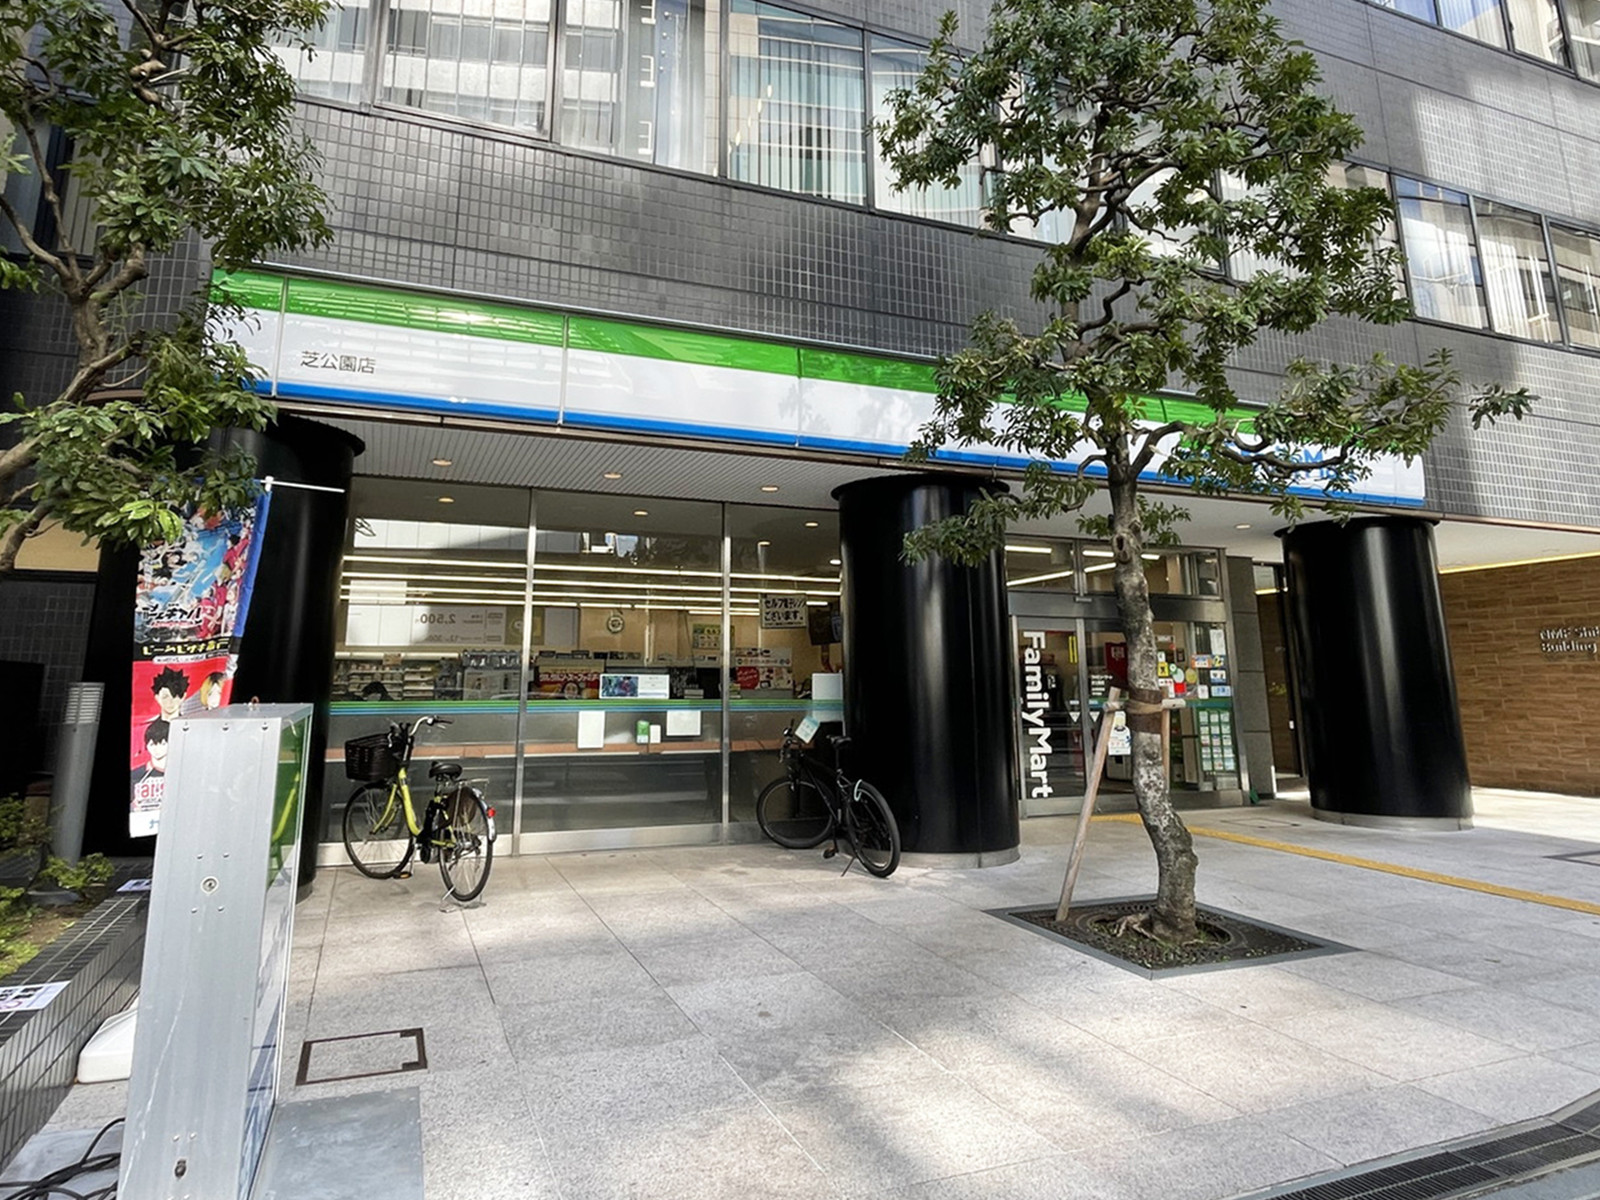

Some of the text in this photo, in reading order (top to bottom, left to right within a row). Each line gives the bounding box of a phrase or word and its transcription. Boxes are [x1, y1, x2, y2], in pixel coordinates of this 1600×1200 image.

[300, 350, 377, 375] 芝公園店
[1541, 640, 1598, 653] Building
[1021, 630, 1054, 799] FamilyMart
